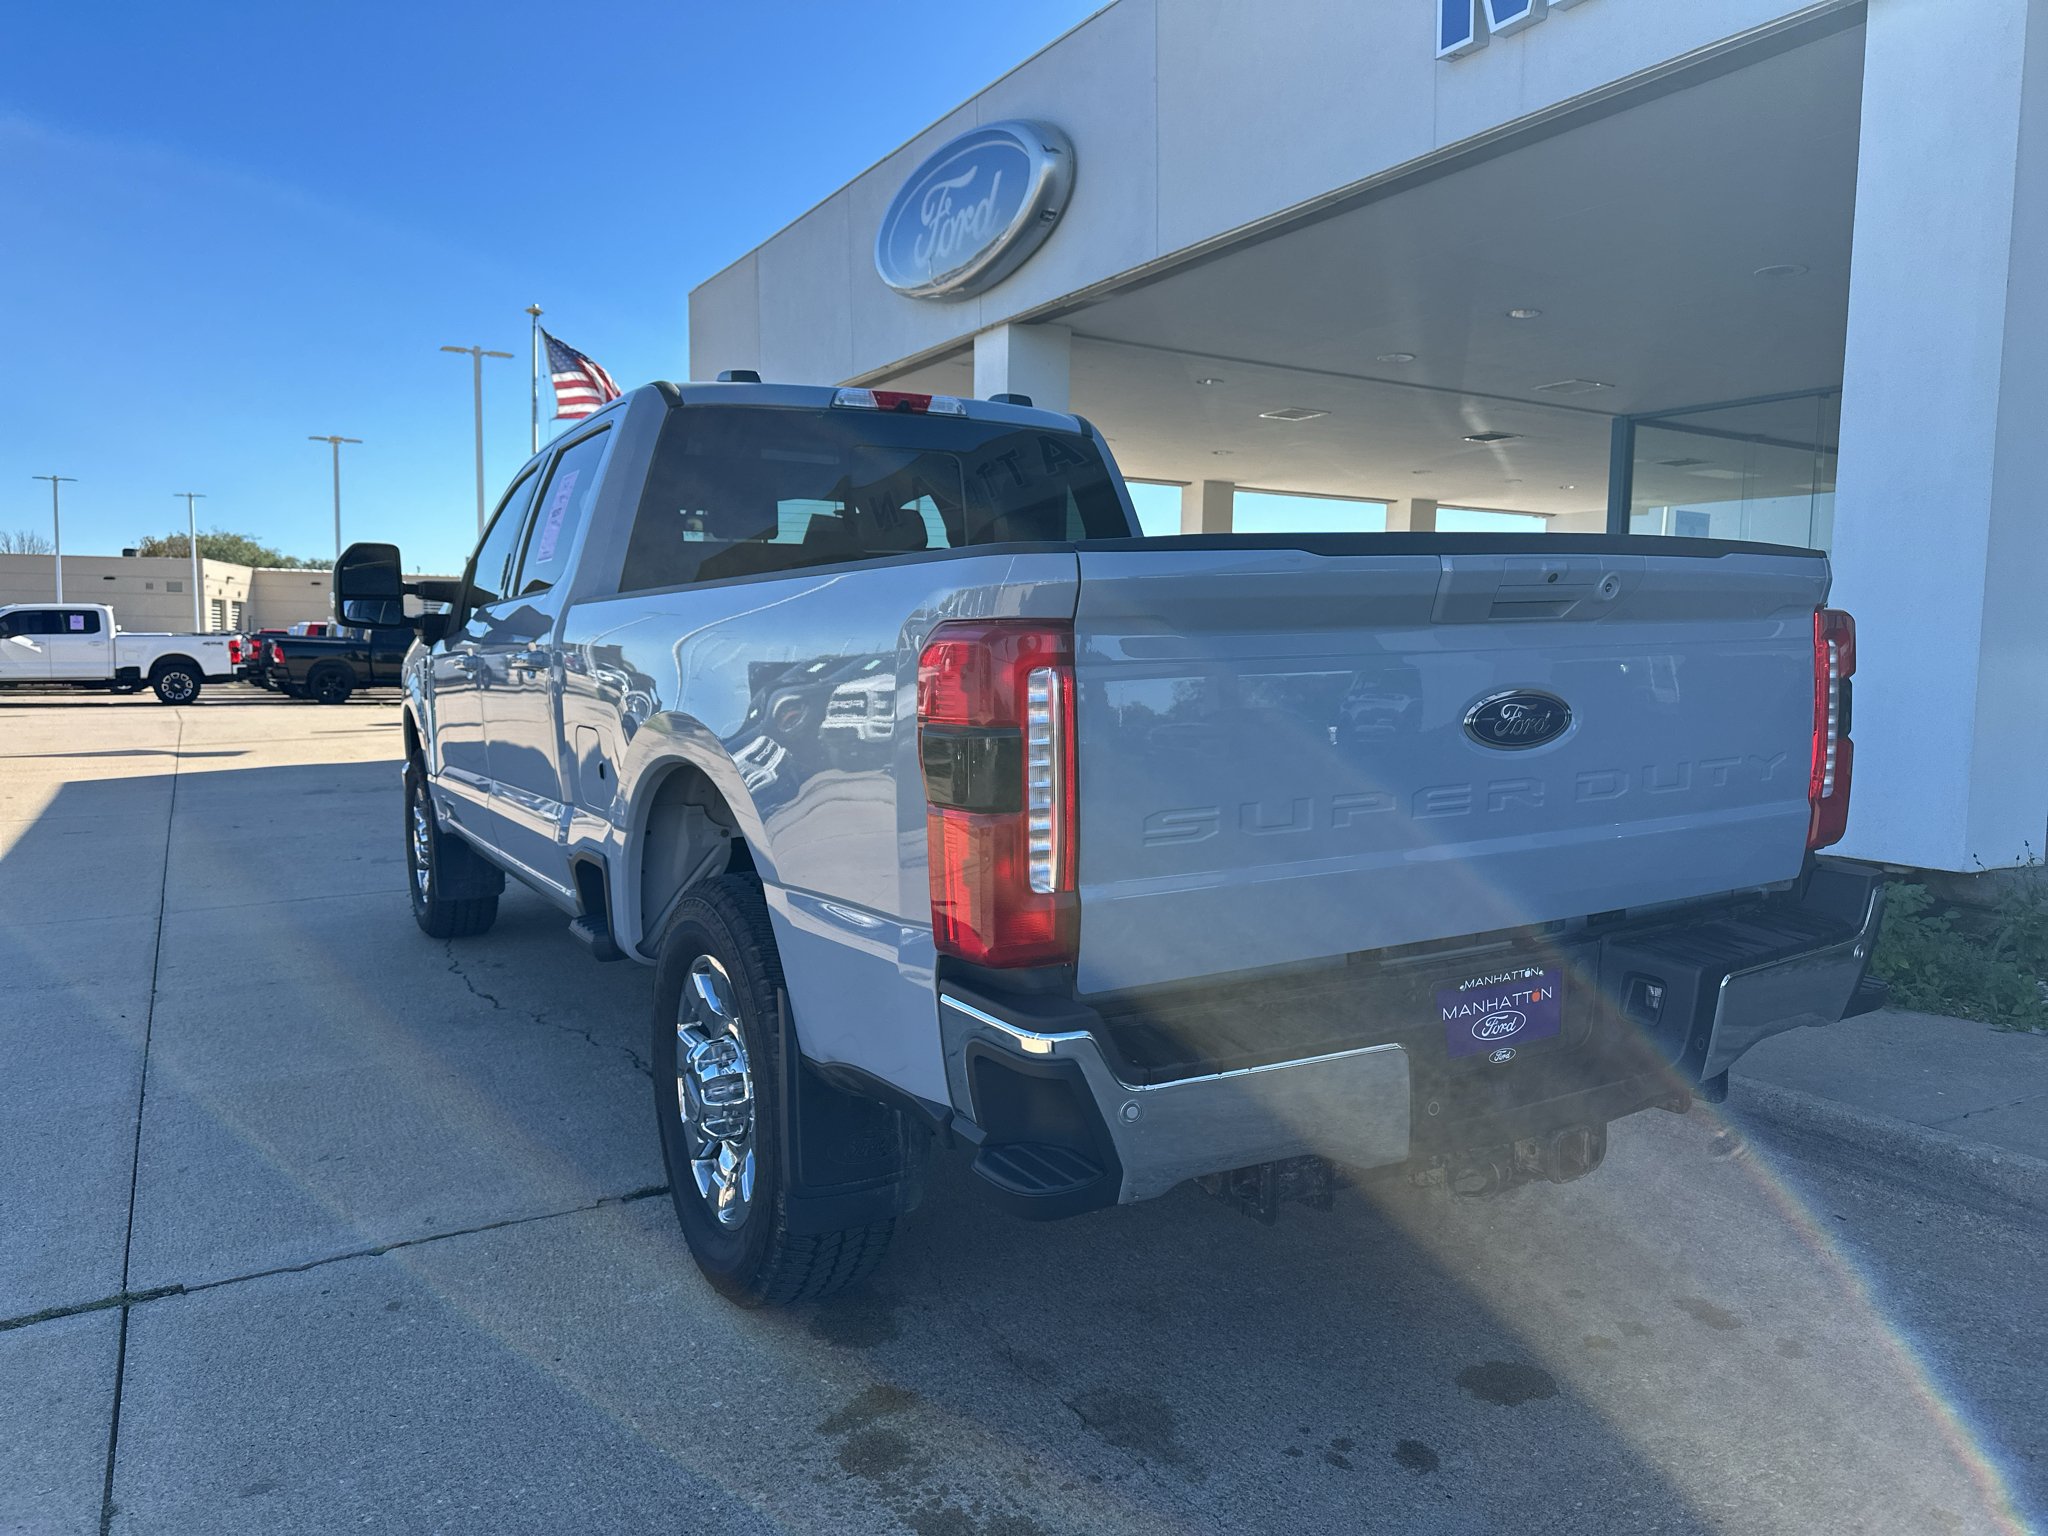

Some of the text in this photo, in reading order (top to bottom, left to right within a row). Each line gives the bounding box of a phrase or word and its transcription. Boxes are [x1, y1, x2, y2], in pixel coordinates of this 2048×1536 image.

[913, 165, 1002, 269] Ford
[1493, 703, 1552, 737] Ford
[1142, 750, 1788, 848] SUPER DUTY
[1481, 1014, 1518, 1037] Ford
[1493, 1050, 1511, 1062] Ford
